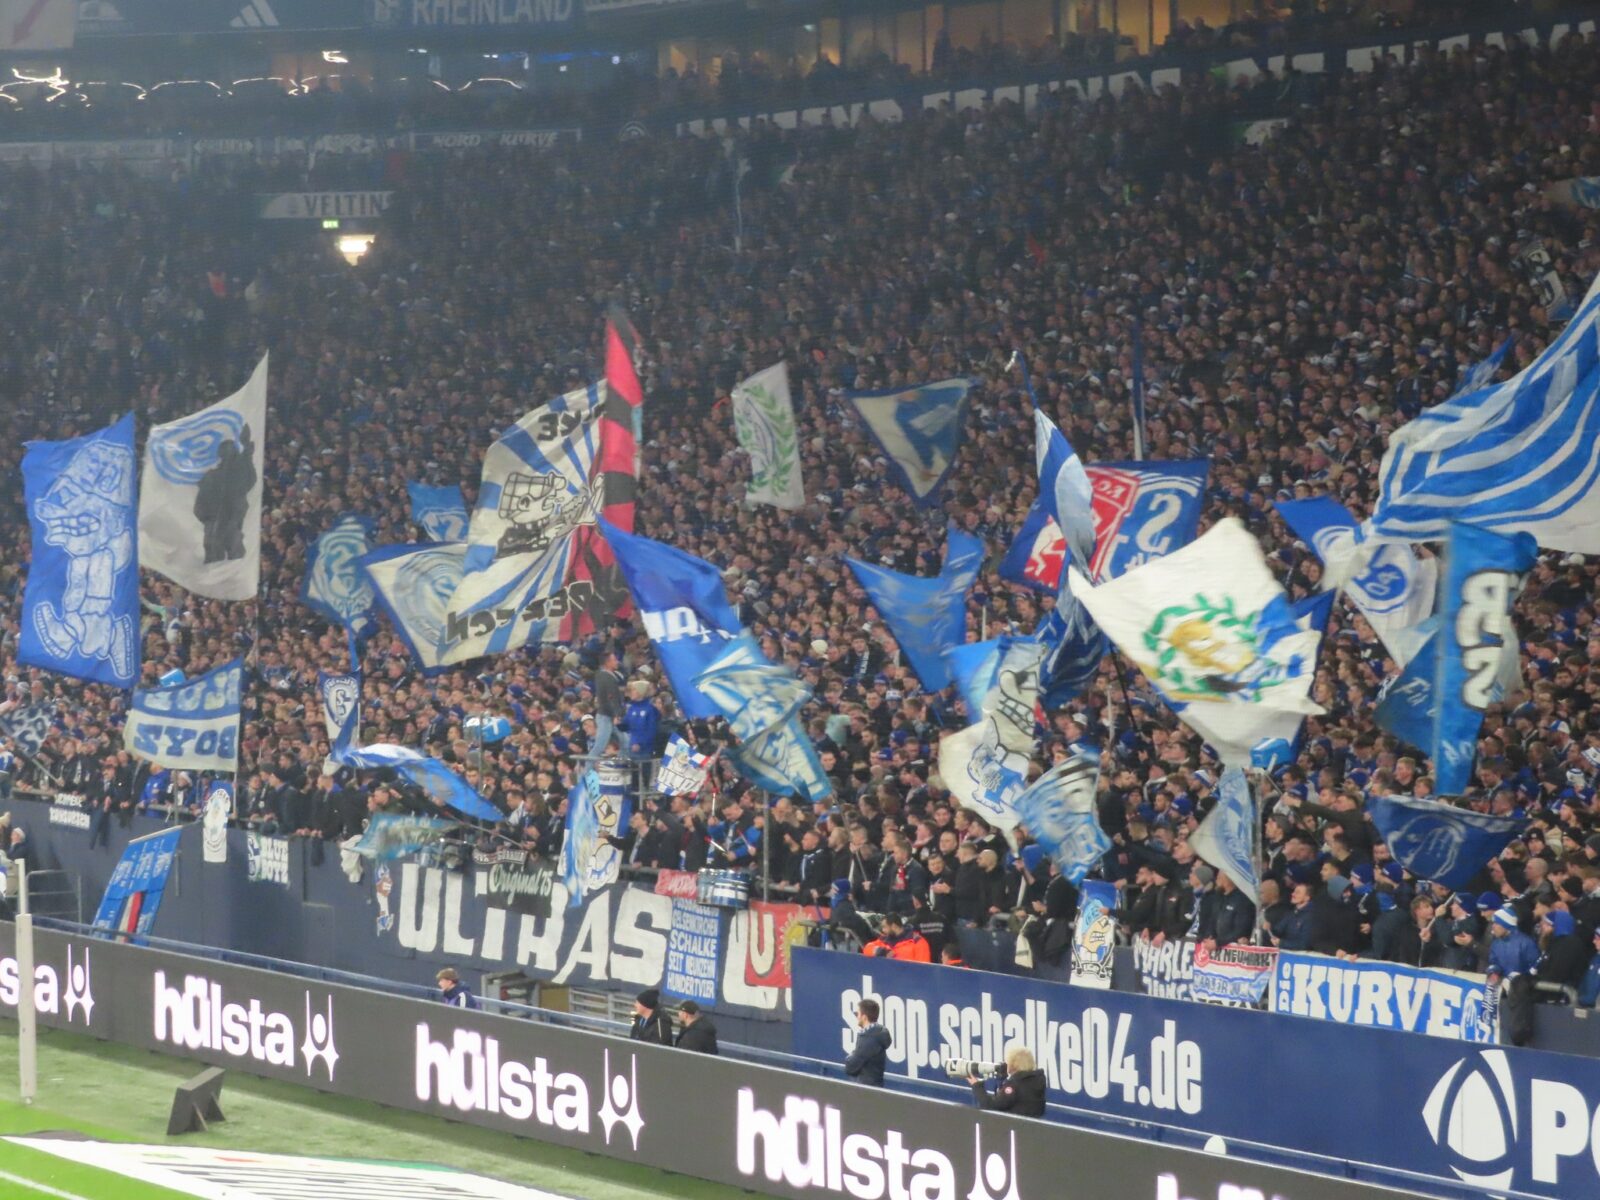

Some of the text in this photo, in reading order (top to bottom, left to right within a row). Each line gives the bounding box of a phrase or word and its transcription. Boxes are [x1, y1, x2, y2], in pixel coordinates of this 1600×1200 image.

[413, 0, 572, 25] RHEINLAND
[489, 862, 541, 905] Original
[399, 861, 674, 988] ULTRAS
[668, 950, 685, 971] SEIT
[670, 929, 717, 958] SCHALKE
[0, 957, 58, 1014] sa
[154, 970, 295, 1068] hülsta
[1291, 963, 1462, 1040] KURVE
[415, 1022, 590, 1134] hülsta
[737, 1087, 955, 1200] hülsta
[1531, 1078, 1600, 1184] P
